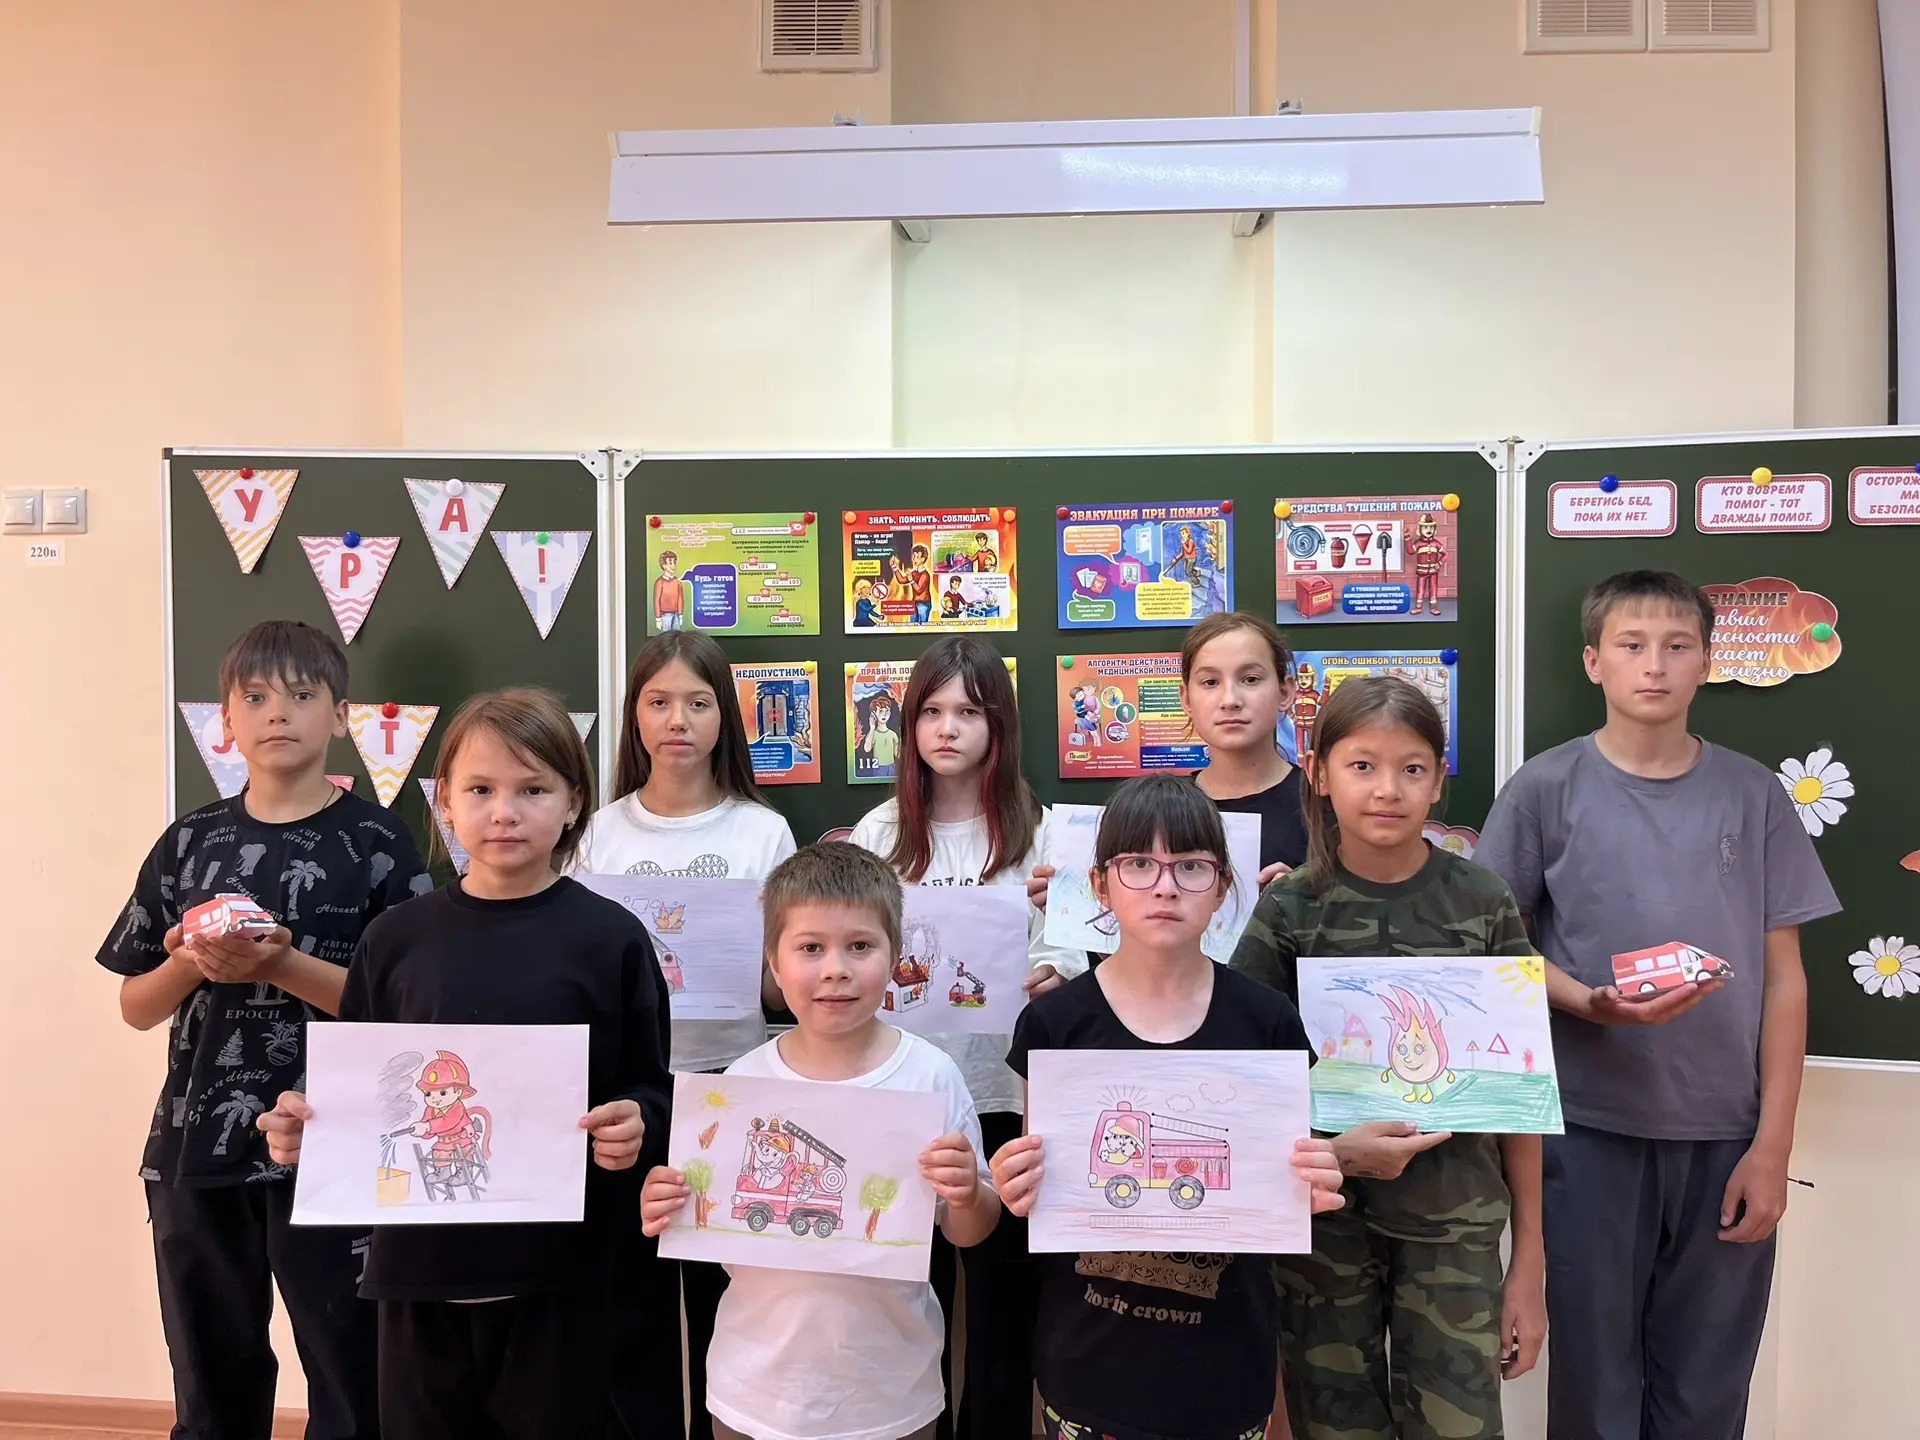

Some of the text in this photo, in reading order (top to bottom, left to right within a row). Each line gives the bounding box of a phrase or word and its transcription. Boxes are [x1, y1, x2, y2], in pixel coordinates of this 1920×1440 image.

[1721, 484, 1805, 496] КТО ВОВРЕМЯ
[1900, 490, 1919, 500] МА
[234, 488, 264, 523] У
[1570, 496, 1653, 506] БЕРЕГИСЬ БЕД,
[1725, 499, 1768, 509] ПОМОГ
[1780, 498, 1801, 508] ТОТ
[1290, 501, 1442, 514] СРЕДСТВА ТУШЕНИЯ ПОЖАРА
[438, 497, 469, 532] А
[942, 514, 991, 523] СОБЛЮДАТЬ
[1070, 507, 1219, 522] ЭВАКУАЦИЯ ПРИ ПОЖАРЕ
[1574, 512, 1648, 522] ПОКА ИХ НЕТ.
[1710, 512, 1813, 524] ДВАЖДЫ ПОМОГ.
[340, 552, 361, 589] Р
[1709, 591, 1789, 607] ЗНАНИЕ
[1713, 608, 1769, 627] авил
[1710, 629, 1800, 644] асности
[1322, 657, 1350, 665] ОГОНЬ
[1352, 657, 1389, 665] ОШИБОК
[1406, 656, 1442, 664] ПРОЩАЕ
[1711, 648, 1768, 661] сает
[1129, 658, 1170, 666] ДЕЙСТВИЙ
[735, 668, 809, 679] НЕДОПУСТИМО
[861, 667, 897, 675] ПРАВИЛА
[1097, 667, 1154, 675] МЕДИЦИНСКОЙ
[1716, 664, 1789, 684] жизнь
[859, 758, 880, 769] 112
[133, 940, 162, 953] EPO
[225, 1009, 281, 1020] EPOCH
[1133, 1303, 1202, 1325] crown
